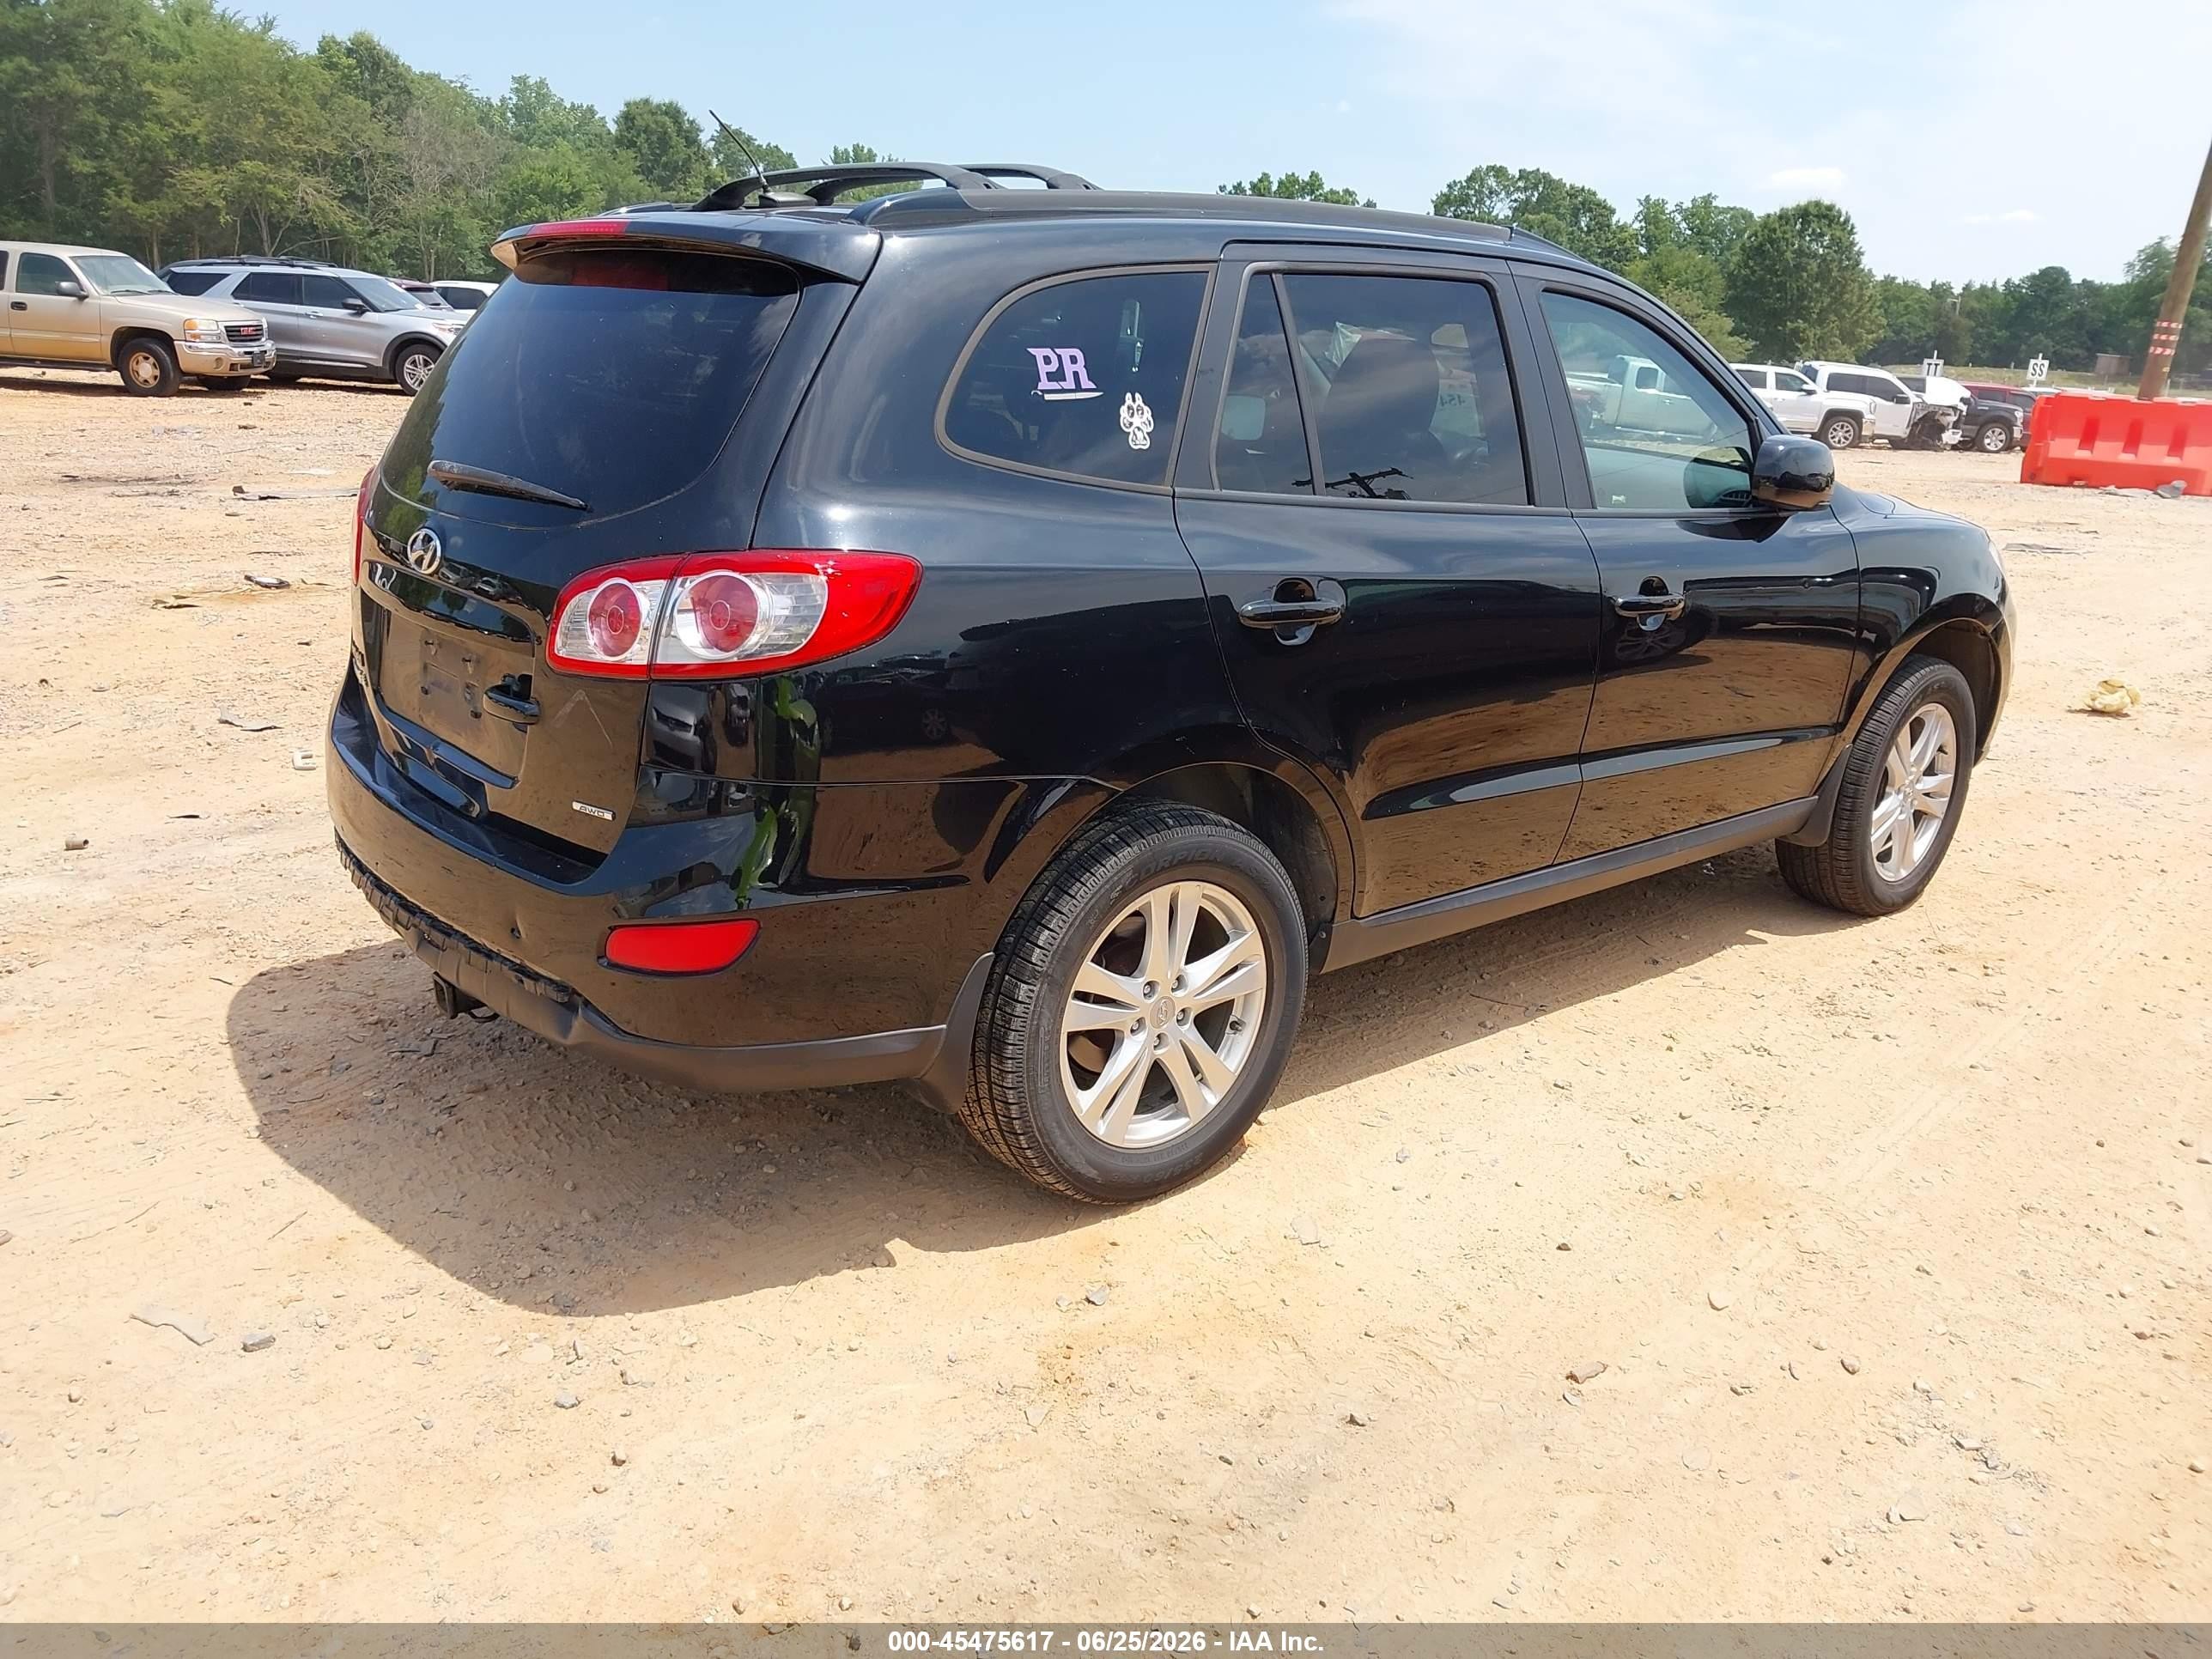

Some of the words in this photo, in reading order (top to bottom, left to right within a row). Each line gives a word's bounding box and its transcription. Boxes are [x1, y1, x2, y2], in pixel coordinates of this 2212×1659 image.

[1026, 348, 1097, 390] PR
[1926, 362, 1941, 376] TT
[2031, 362, 2045, 377] SS
